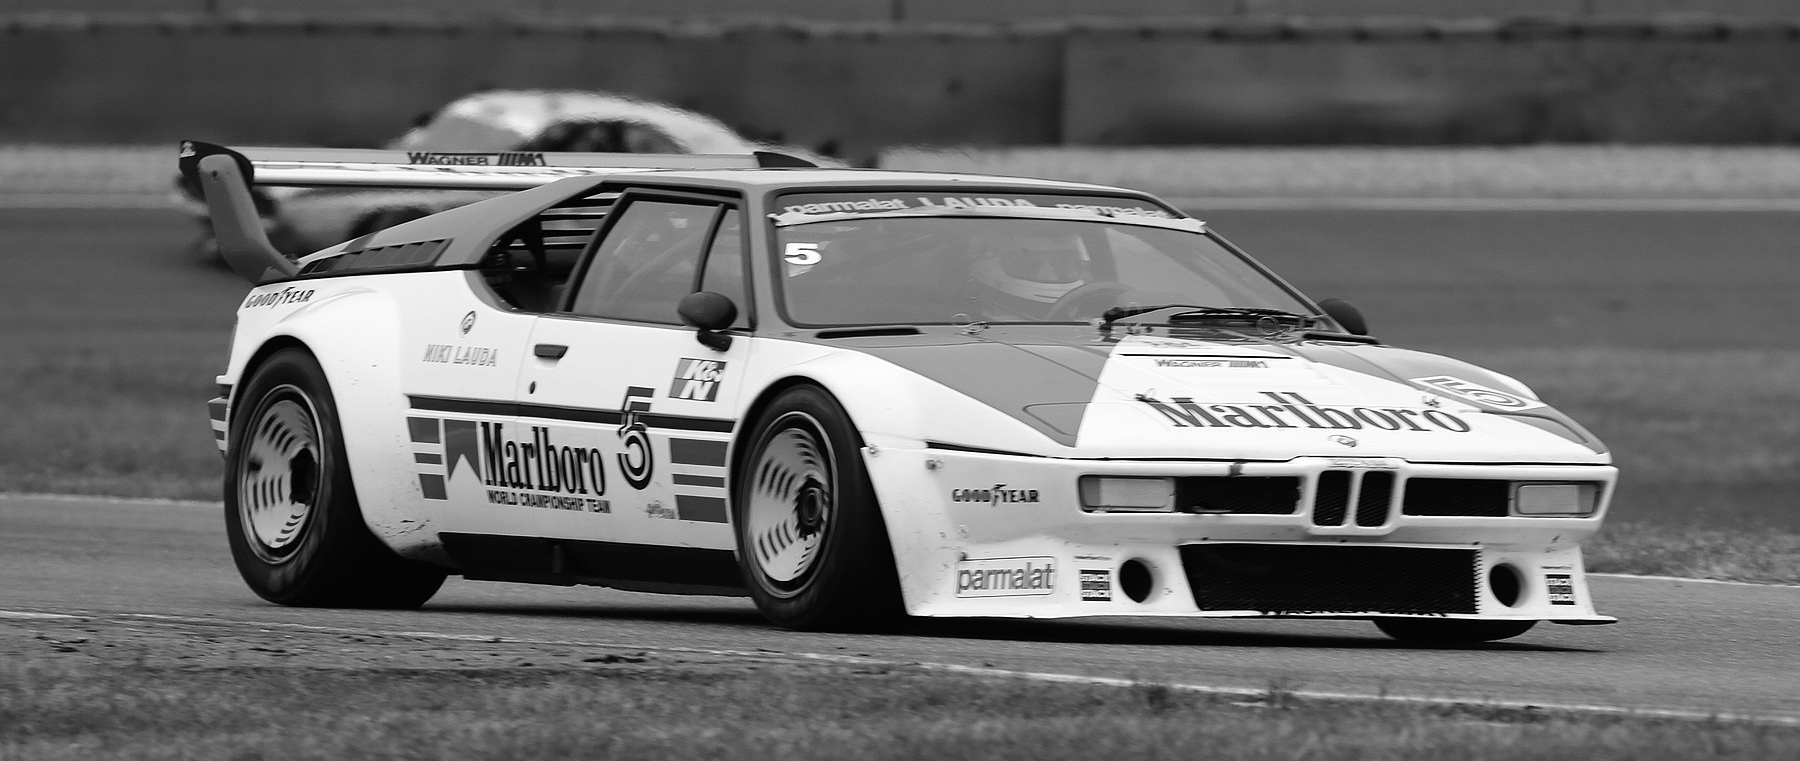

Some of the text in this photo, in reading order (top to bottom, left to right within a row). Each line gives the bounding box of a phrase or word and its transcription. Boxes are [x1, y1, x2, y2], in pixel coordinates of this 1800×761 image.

[784, 242, 822, 265] 5
[422, 344, 498, 367] NIKI LAUDA
[1147, 391, 1471, 433] Marlboro
[617, 386, 656, 491] 5
[481, 421, 607, 497] Marlboro
[486, 489, 612, 513] WORLD CHAMPIONSHIP TEAM
[957, 561, 1056, 594] parmalat
